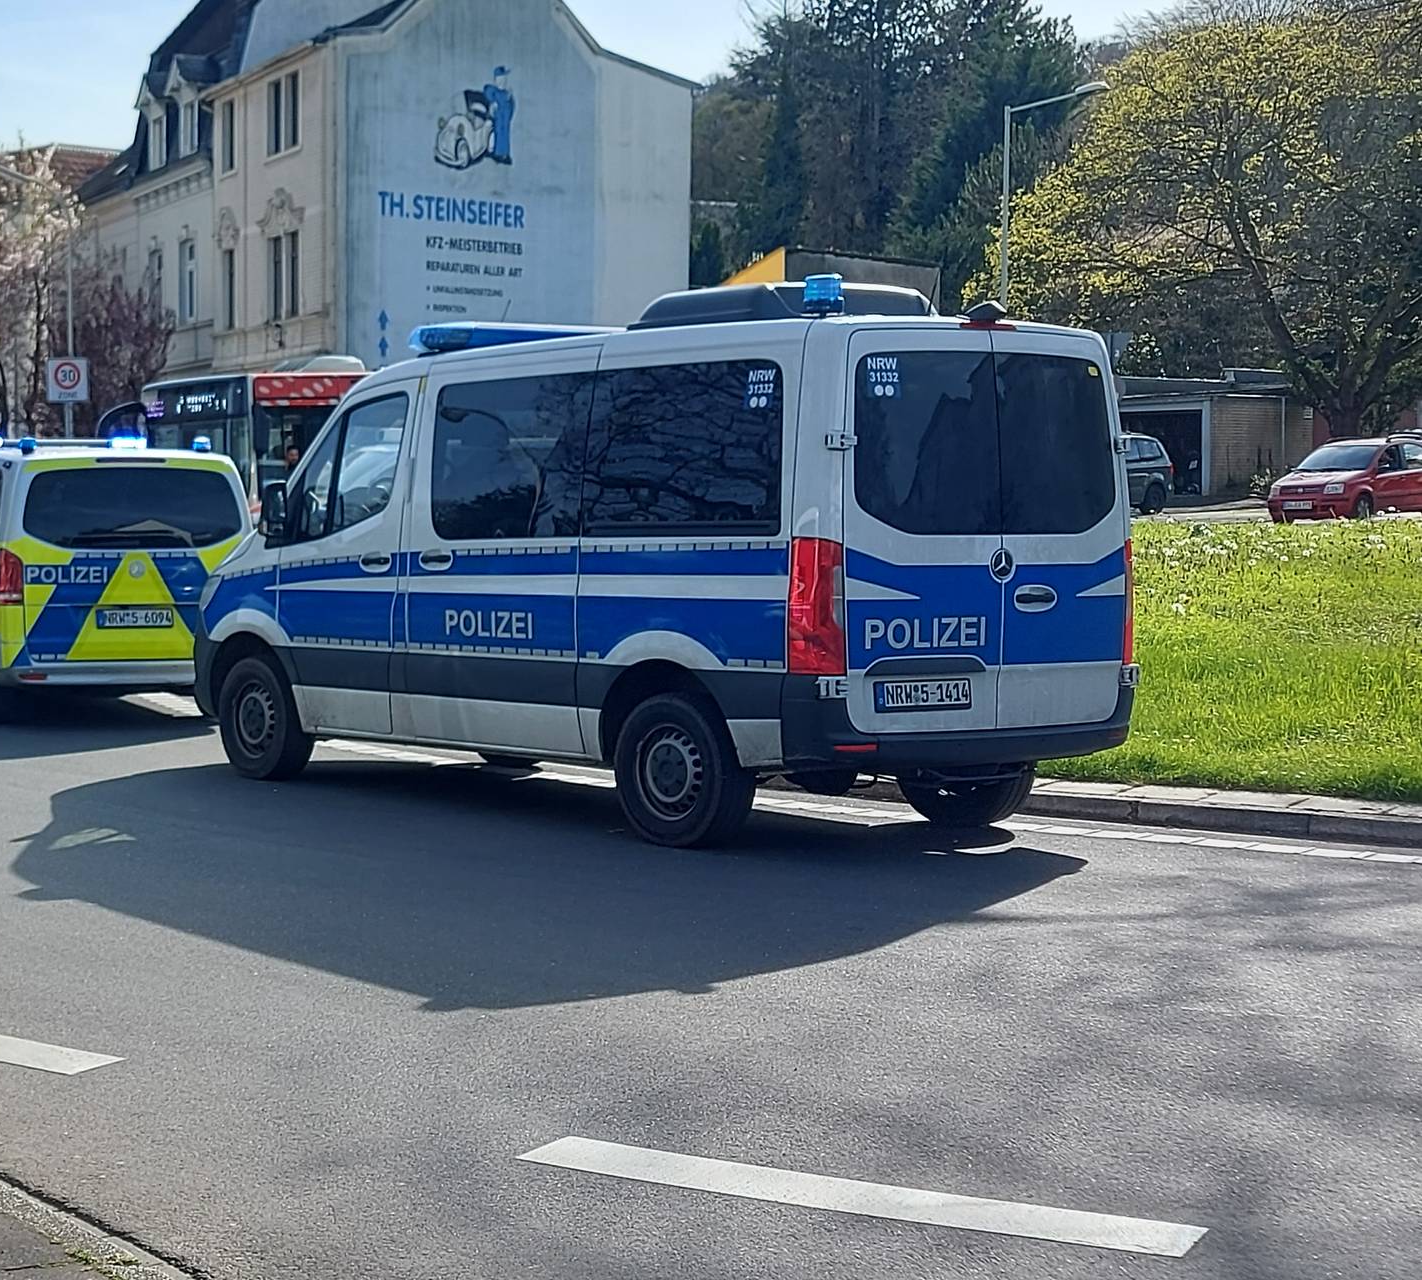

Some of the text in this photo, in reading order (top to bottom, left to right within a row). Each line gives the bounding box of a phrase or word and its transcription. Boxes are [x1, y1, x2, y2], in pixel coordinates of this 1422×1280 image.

[378, 190, 525, 229] TH. STEINSEIFER
[867, 357, 897, 370] NRW
[60, 369, 76, 383] 30
[748, 369, 777, 383] NRW
[869, 372, 899, 383] 31332
[747, 383, 774, 395] 31332
[26, 565, 109, 584] POLIZEI
[445, 609, 533, 640] POLIZEI
[864, 616, 987, 650] POLIZEI
